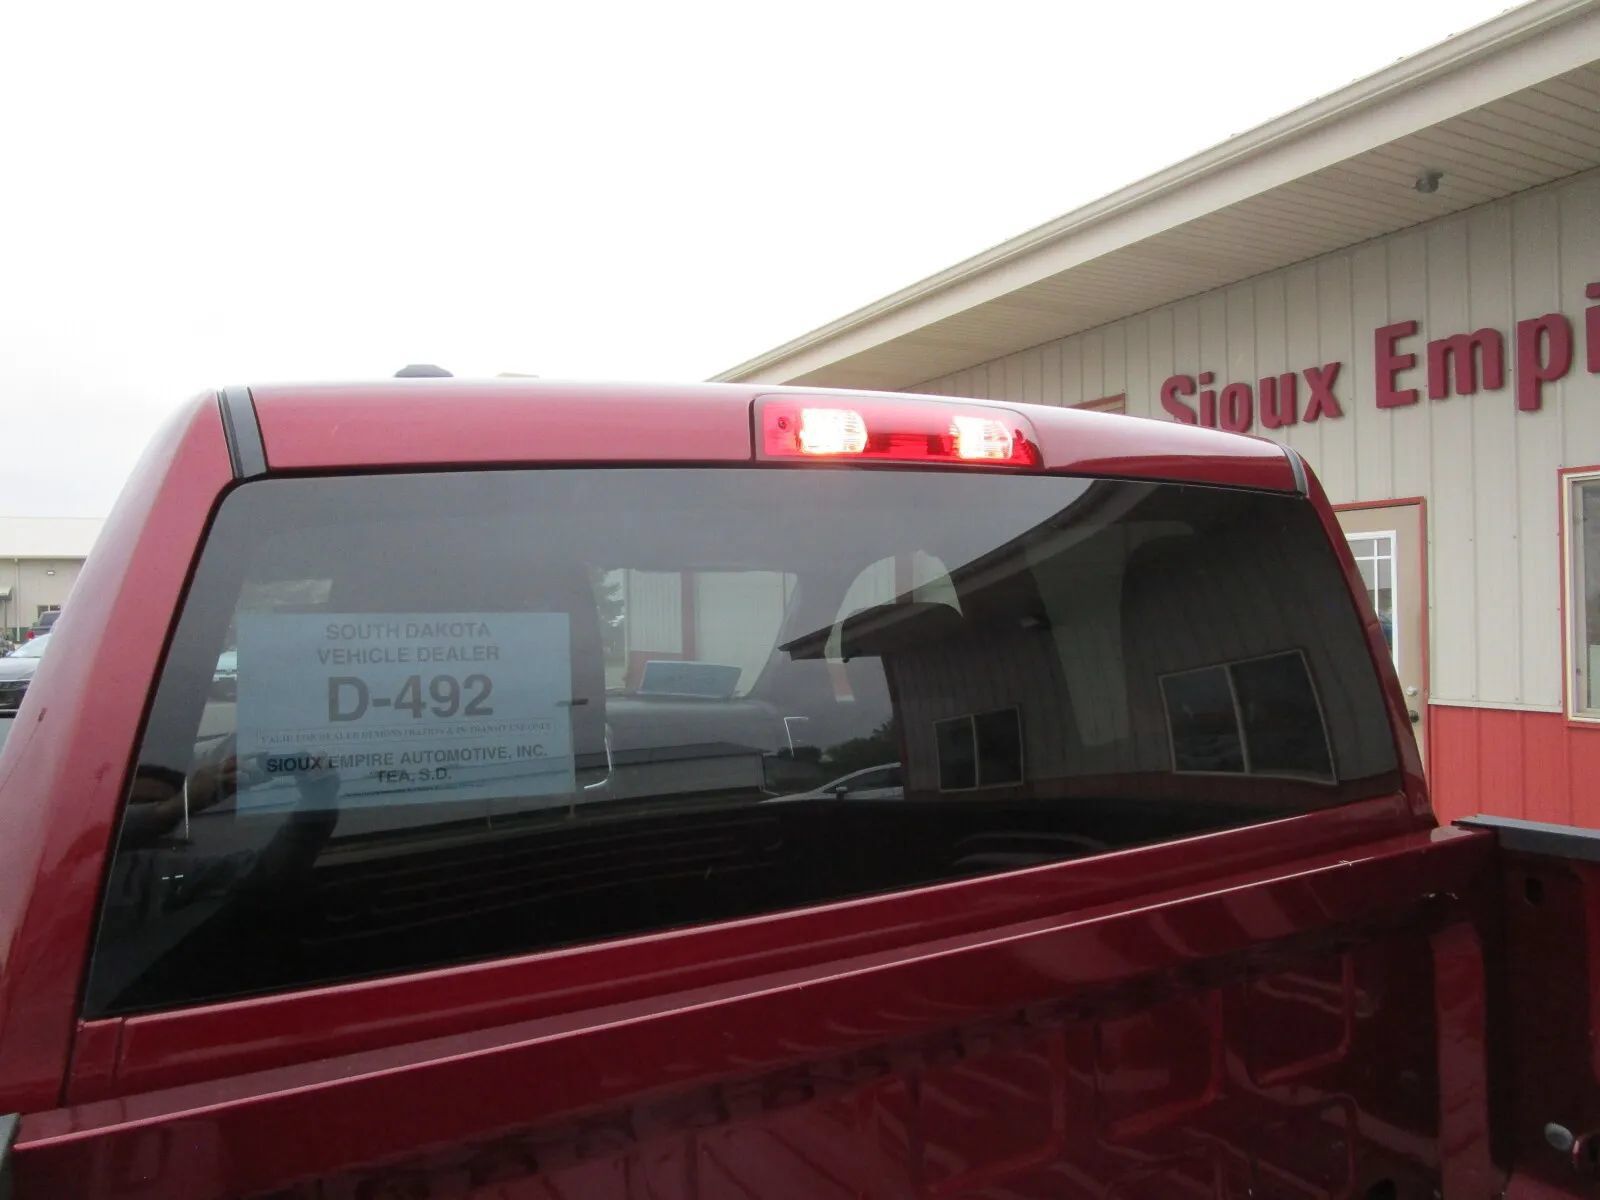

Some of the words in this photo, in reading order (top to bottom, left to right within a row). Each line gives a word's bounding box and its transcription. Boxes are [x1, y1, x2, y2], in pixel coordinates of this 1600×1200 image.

[1161, 361, 1343, 433] Sioux
[325, 623, 399, 640] SOUTH
[405, 622, 491, 639] DAKOTA
[318, 648, 410, 665] VEHICLE
[417, 645, 500, 662] DEALER
[328, 673, 494, 722] D-492
[267, 756, 322, 772] SIOUX
[328, 752, 393, 768] EMPIRE
[517, 744, 548, 758] INC.
